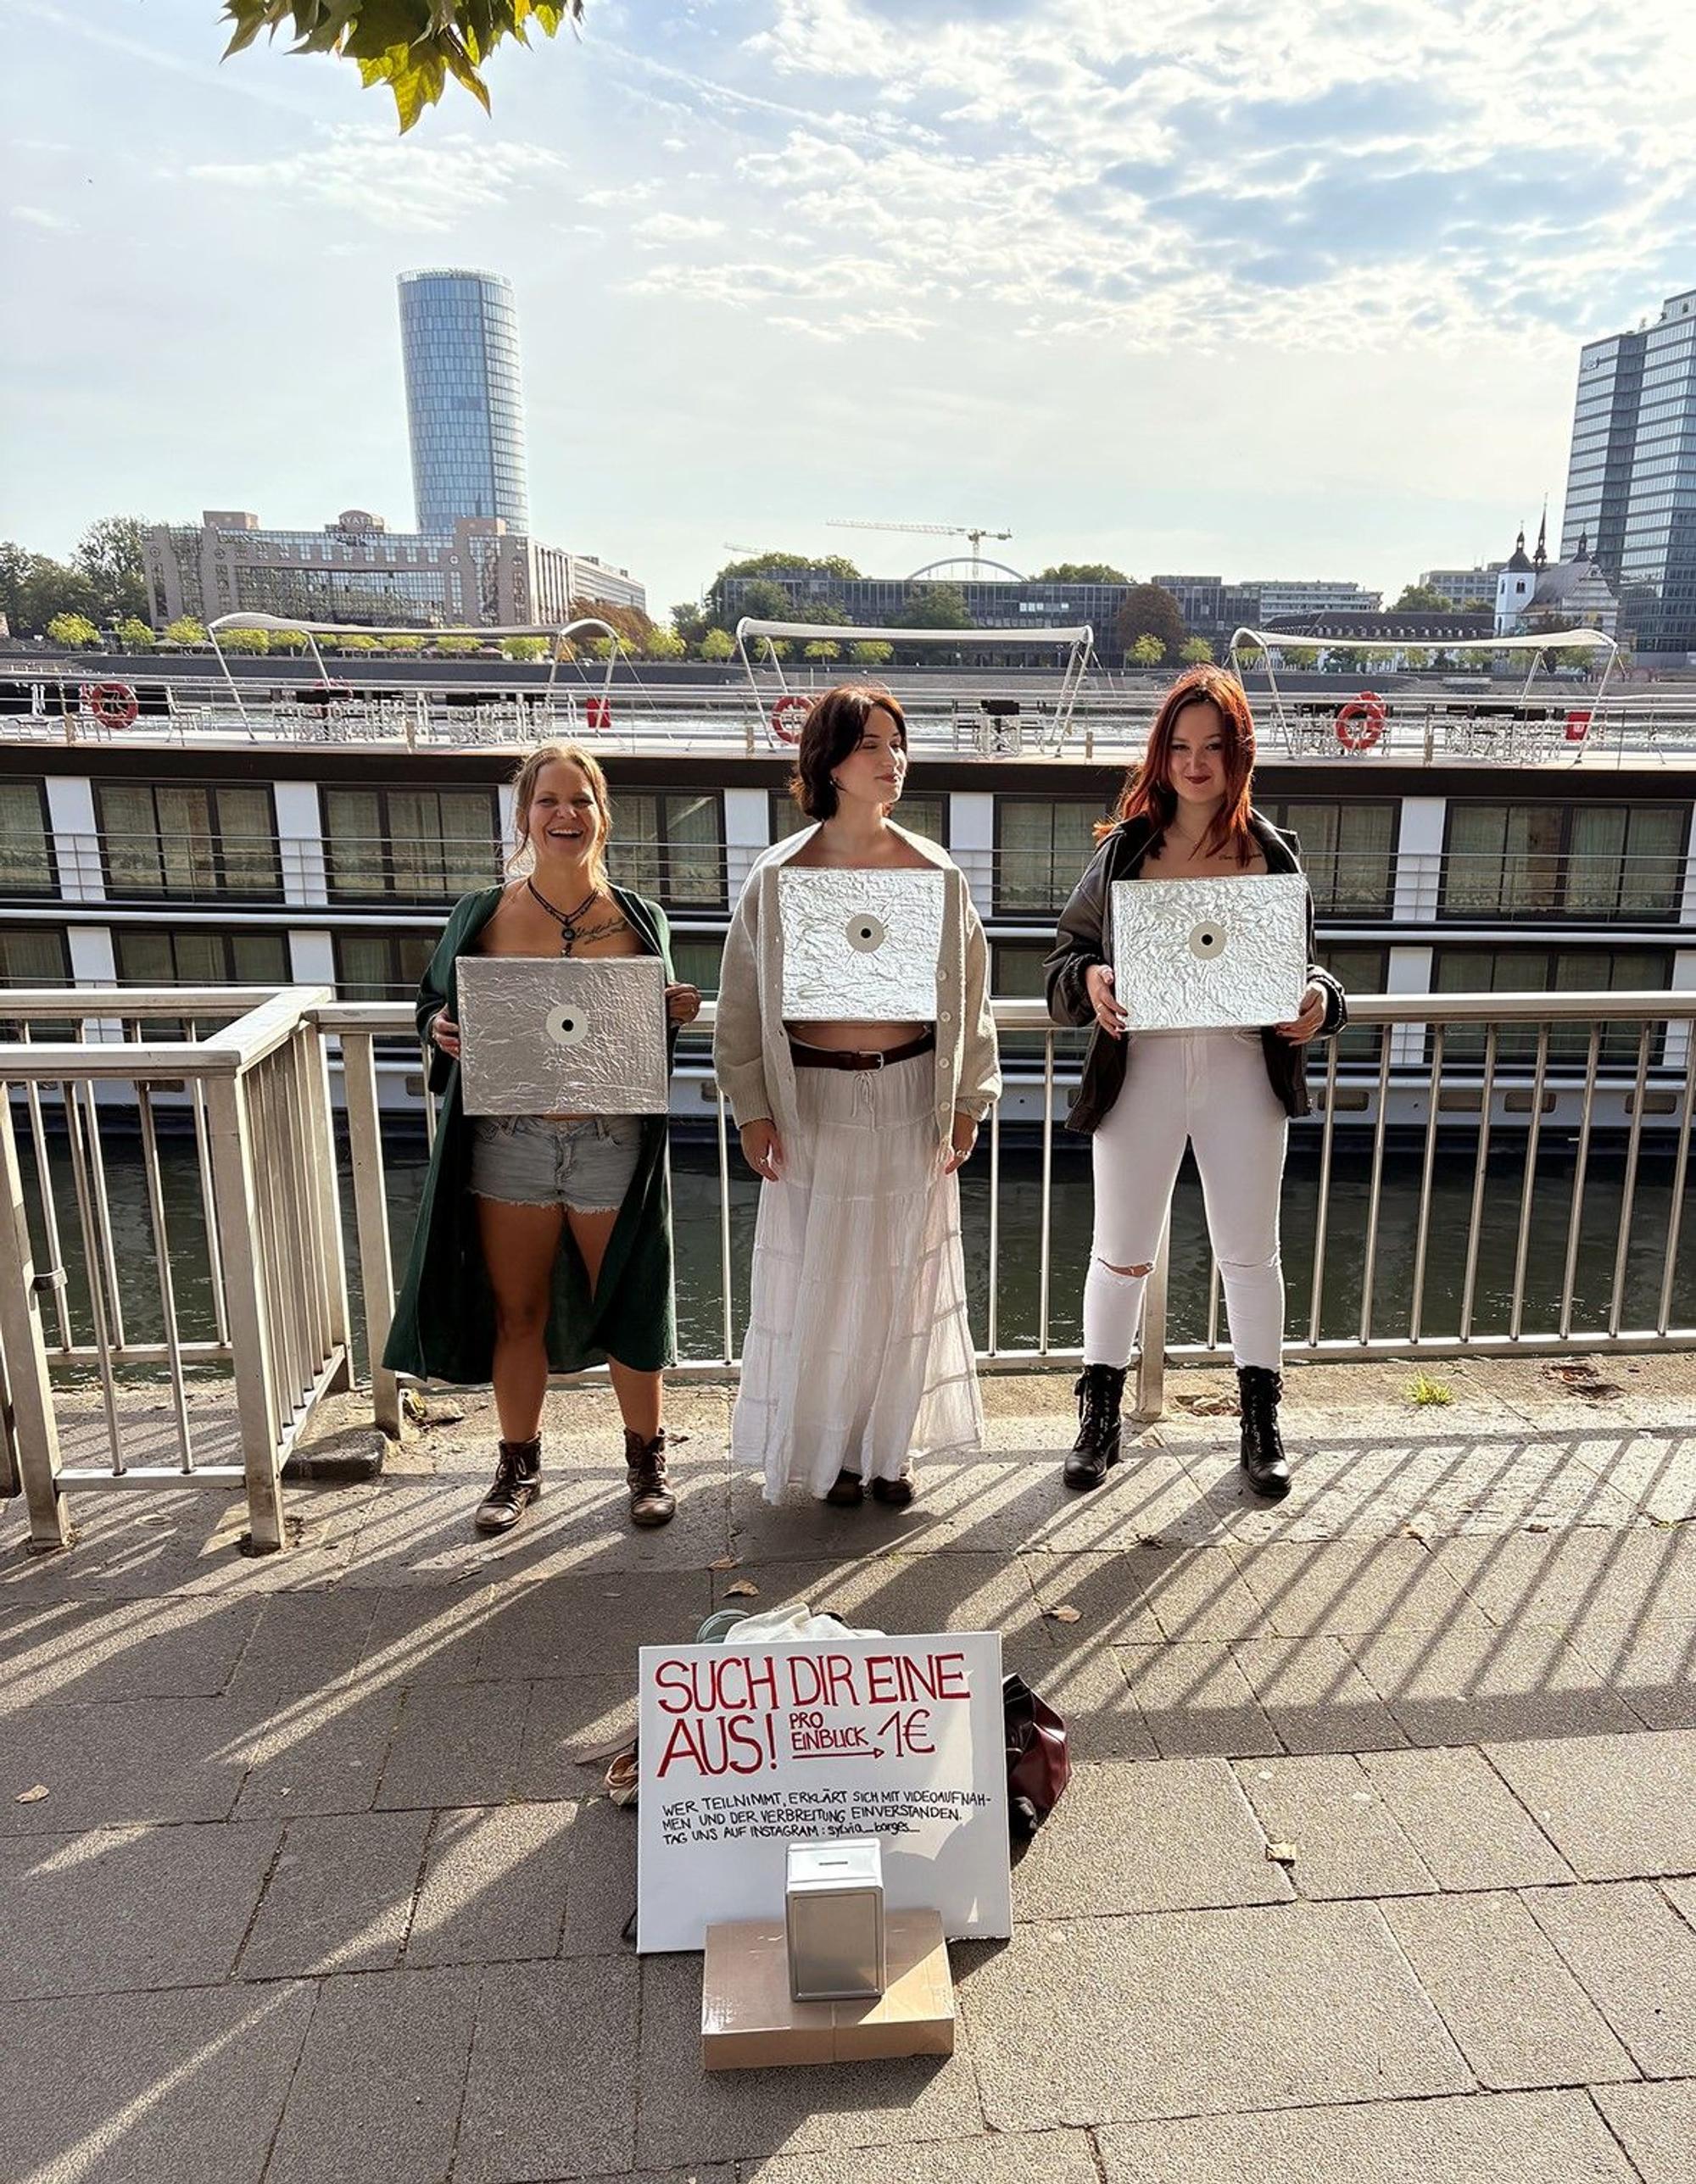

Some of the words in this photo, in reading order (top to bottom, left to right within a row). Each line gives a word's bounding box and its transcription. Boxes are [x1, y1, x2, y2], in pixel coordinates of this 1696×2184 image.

[655, 1656, 779, 1713] SUCH
[787, 1655, 859, 1707] DIR
[865, 1653, 971, 1703] EINE
[789, 1712, 824, 1730] PRO
[878, 1708, 936, 1758] 1€
[657, 1713, 778, 1777] AUS!
[790, 1727, 869, 1751] EINBLICK
[662, 1800, 699, 1817] WER
[701, 1791, 787, 1811] TEILNIMMT,
[853, 1791, 879, 1803] SICH
[881, 1791, 901, 1802] MIT
[903, 1790, 991, 1807] VIDEOAUFNAH-
[662, 1818, 691, 1831] MEN
[699, 1814, 726, 1826] UND
[729, 1810, 758, 1824] DER
[761, 1808, 846, 1824] VERBREITUNG
[851, 1804, 963, 1821] EINVERSTANDEN.
[662, 1832, 688, 1846] TAG
[691, 1828, 718, 1841] UNS
[723, 1826, 747, 1839] AUF
